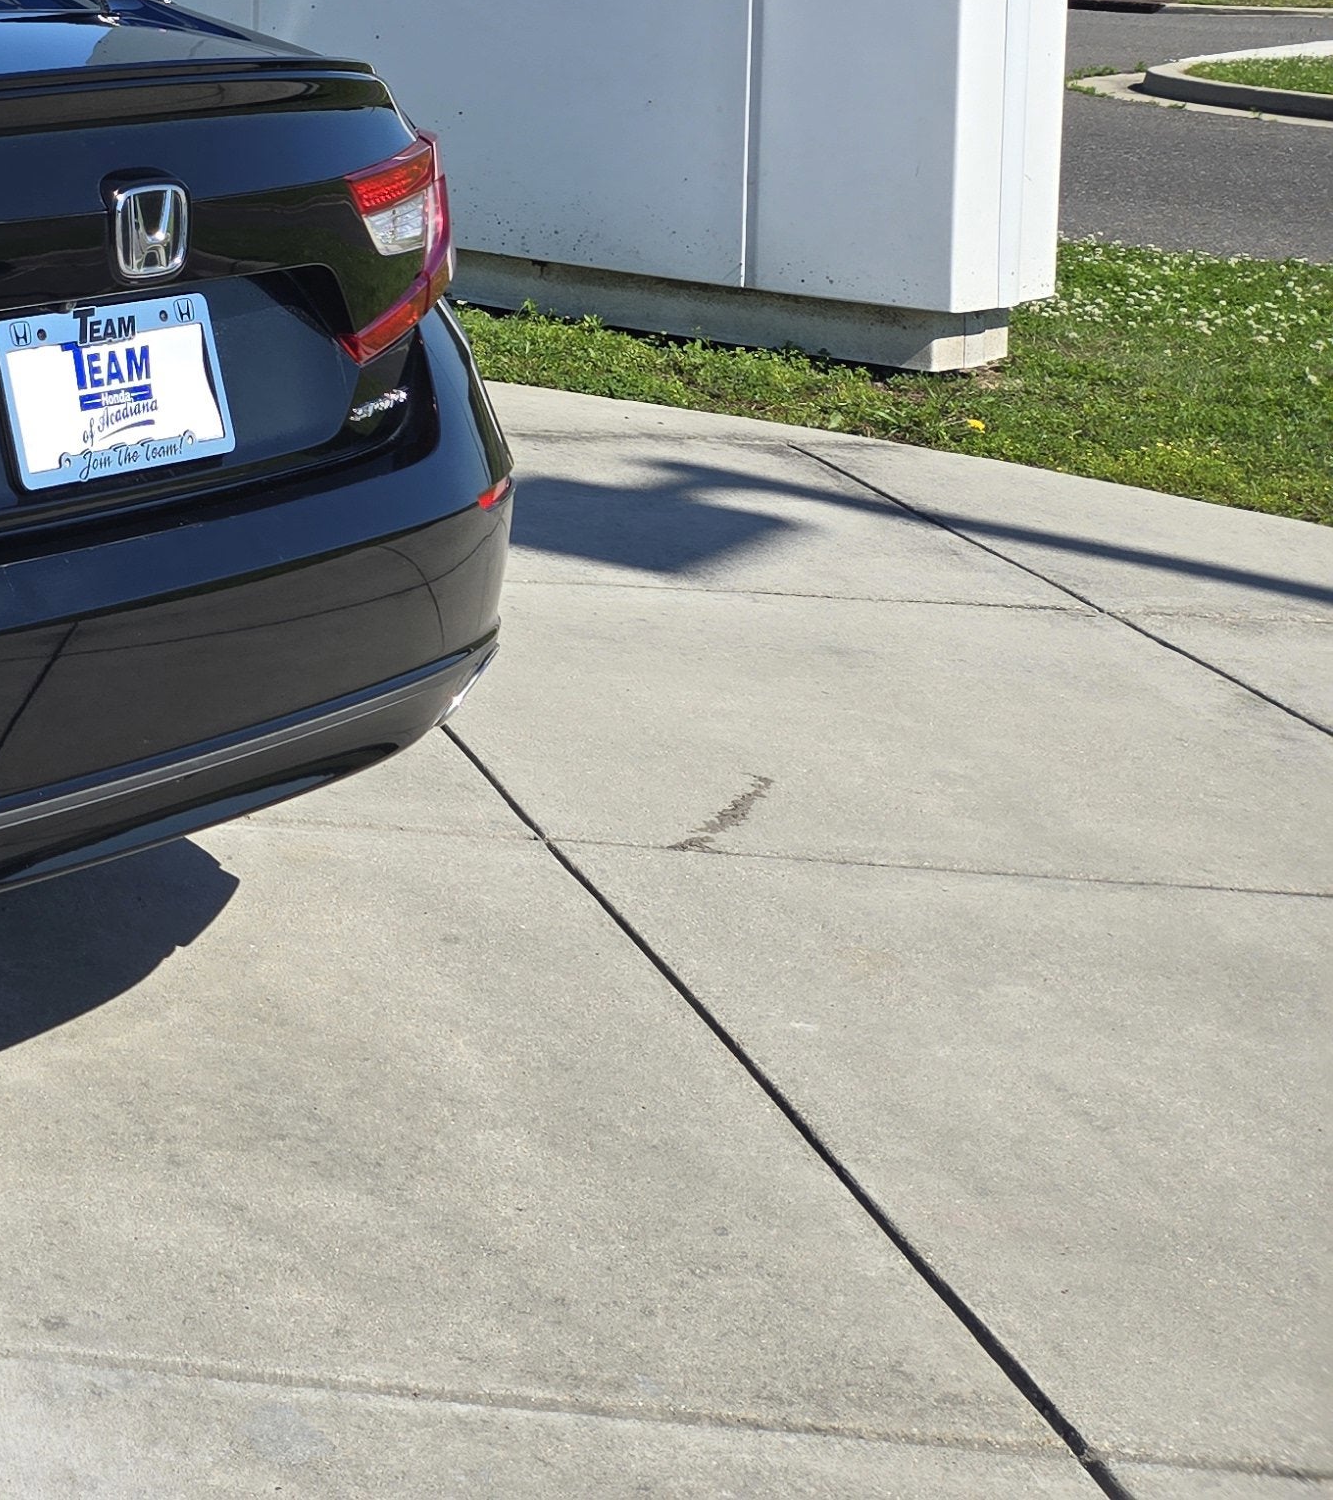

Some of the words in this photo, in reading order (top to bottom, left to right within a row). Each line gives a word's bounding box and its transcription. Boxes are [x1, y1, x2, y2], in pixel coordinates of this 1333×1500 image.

[73, 307, 136, 345] TEAM
[62, 342, 151, 390] TEAM
[101, 389, 133, 407] Honda
[83, 417, 95, 447] of
[97, 398, 158, 432] Acadiana
[79, 450, 112, 480] Join
[113, 444, 140, 467] The
